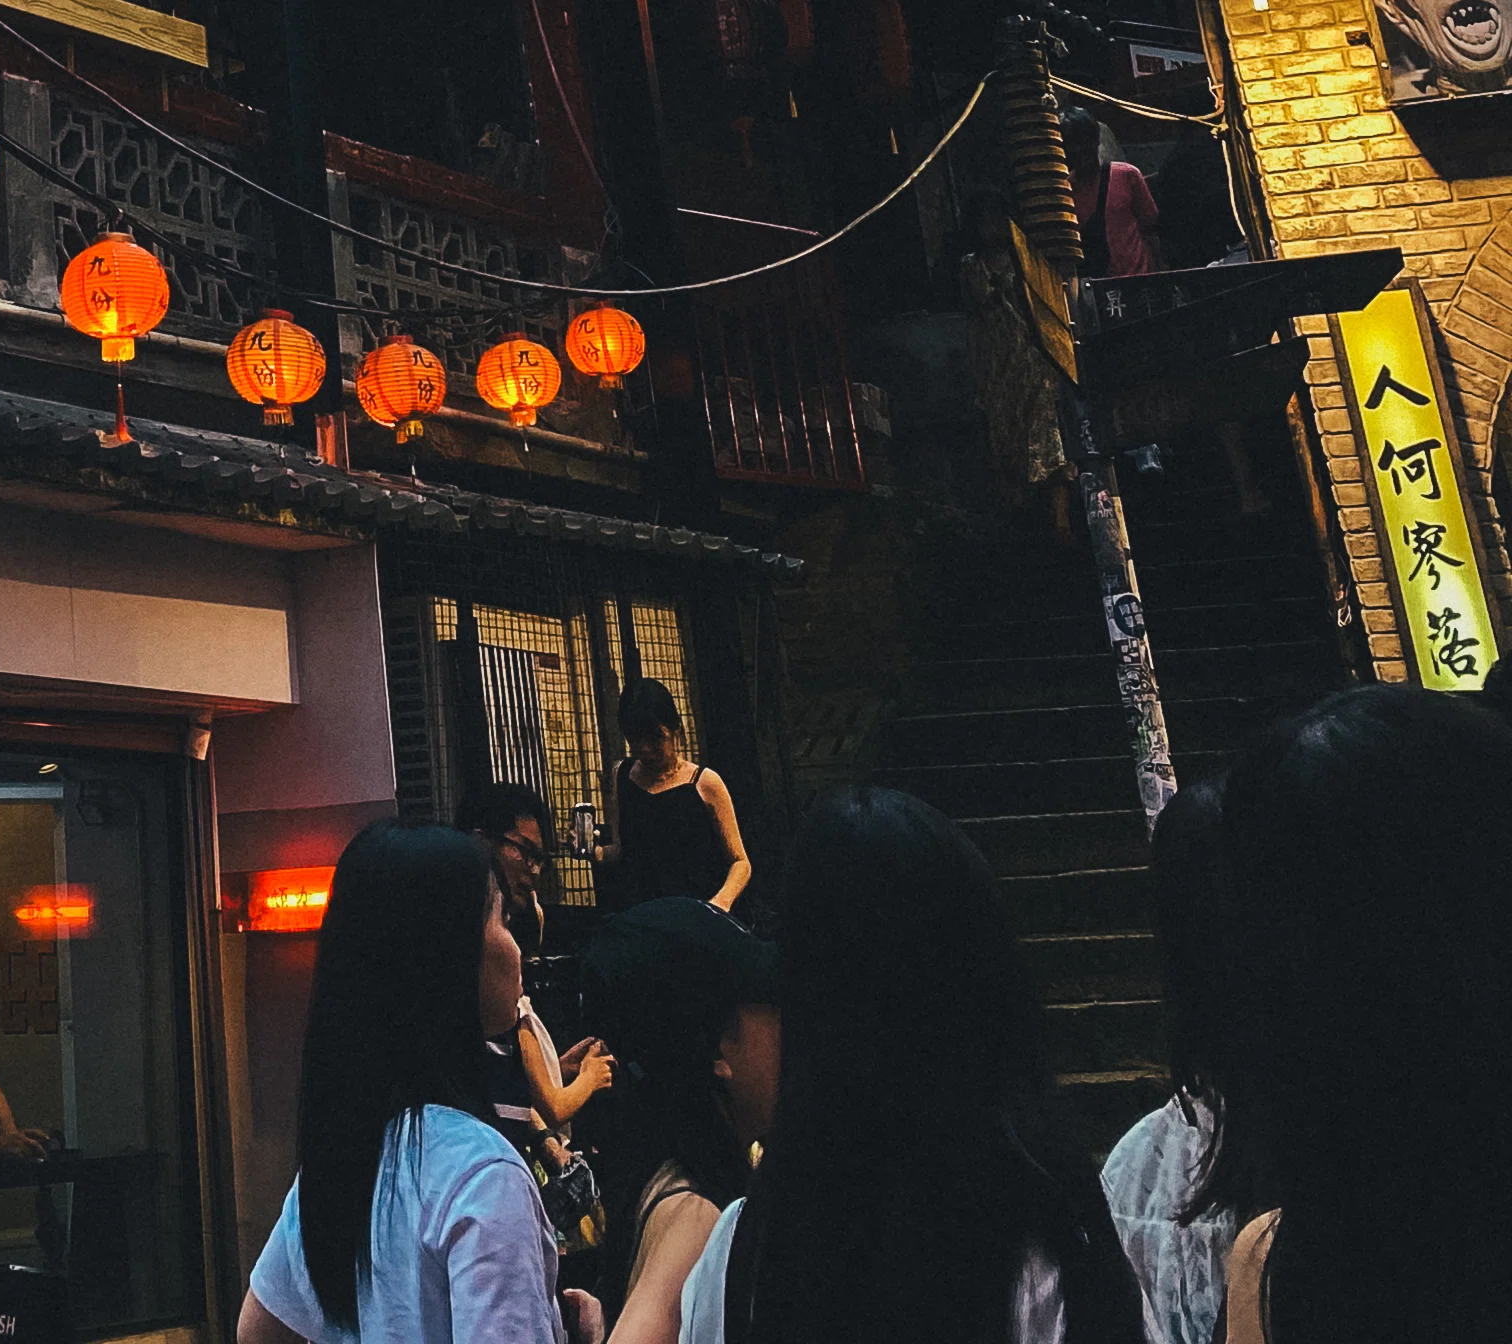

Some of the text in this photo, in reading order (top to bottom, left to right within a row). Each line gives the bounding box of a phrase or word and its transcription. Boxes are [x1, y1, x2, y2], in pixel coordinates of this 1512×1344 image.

[88, 255, 117, 312] 九份
[250, 330, 277, 389] 九份
[412, 349, 435, 404] 九份
[518, 350, 541, 397] 九份
[1363, 364, 1480, 678] 人何寥落
